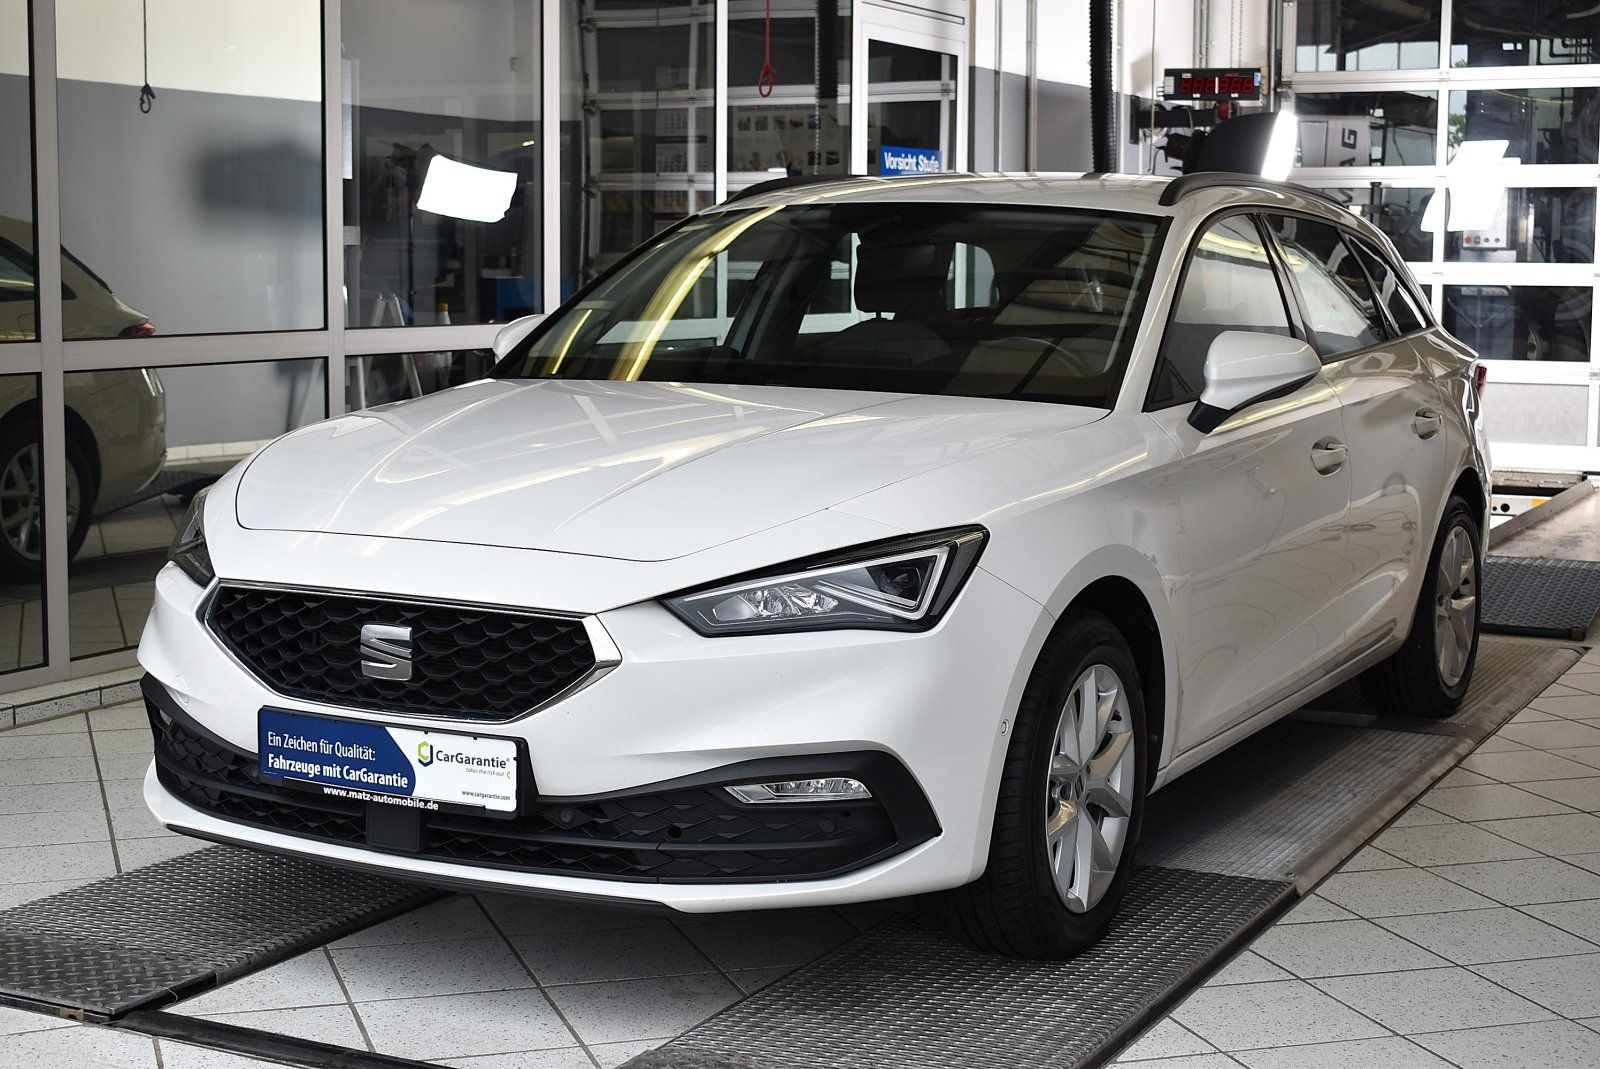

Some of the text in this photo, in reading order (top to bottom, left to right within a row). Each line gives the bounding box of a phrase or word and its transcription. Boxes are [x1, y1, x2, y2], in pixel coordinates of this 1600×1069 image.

[884, 152, 939, 172] Vorsicht Stufe
[268, 731, 376, 761] Ein Zeichen für Qualität:
[436, 750, 507, 769] CarGarantie
[268, 754, 408, 788] Fahrzeuge mit CarGarantie
[323, 787, 439, 811] www.matz-automobile.de
[461, 790, 511, 801] www.cargarantie.com
